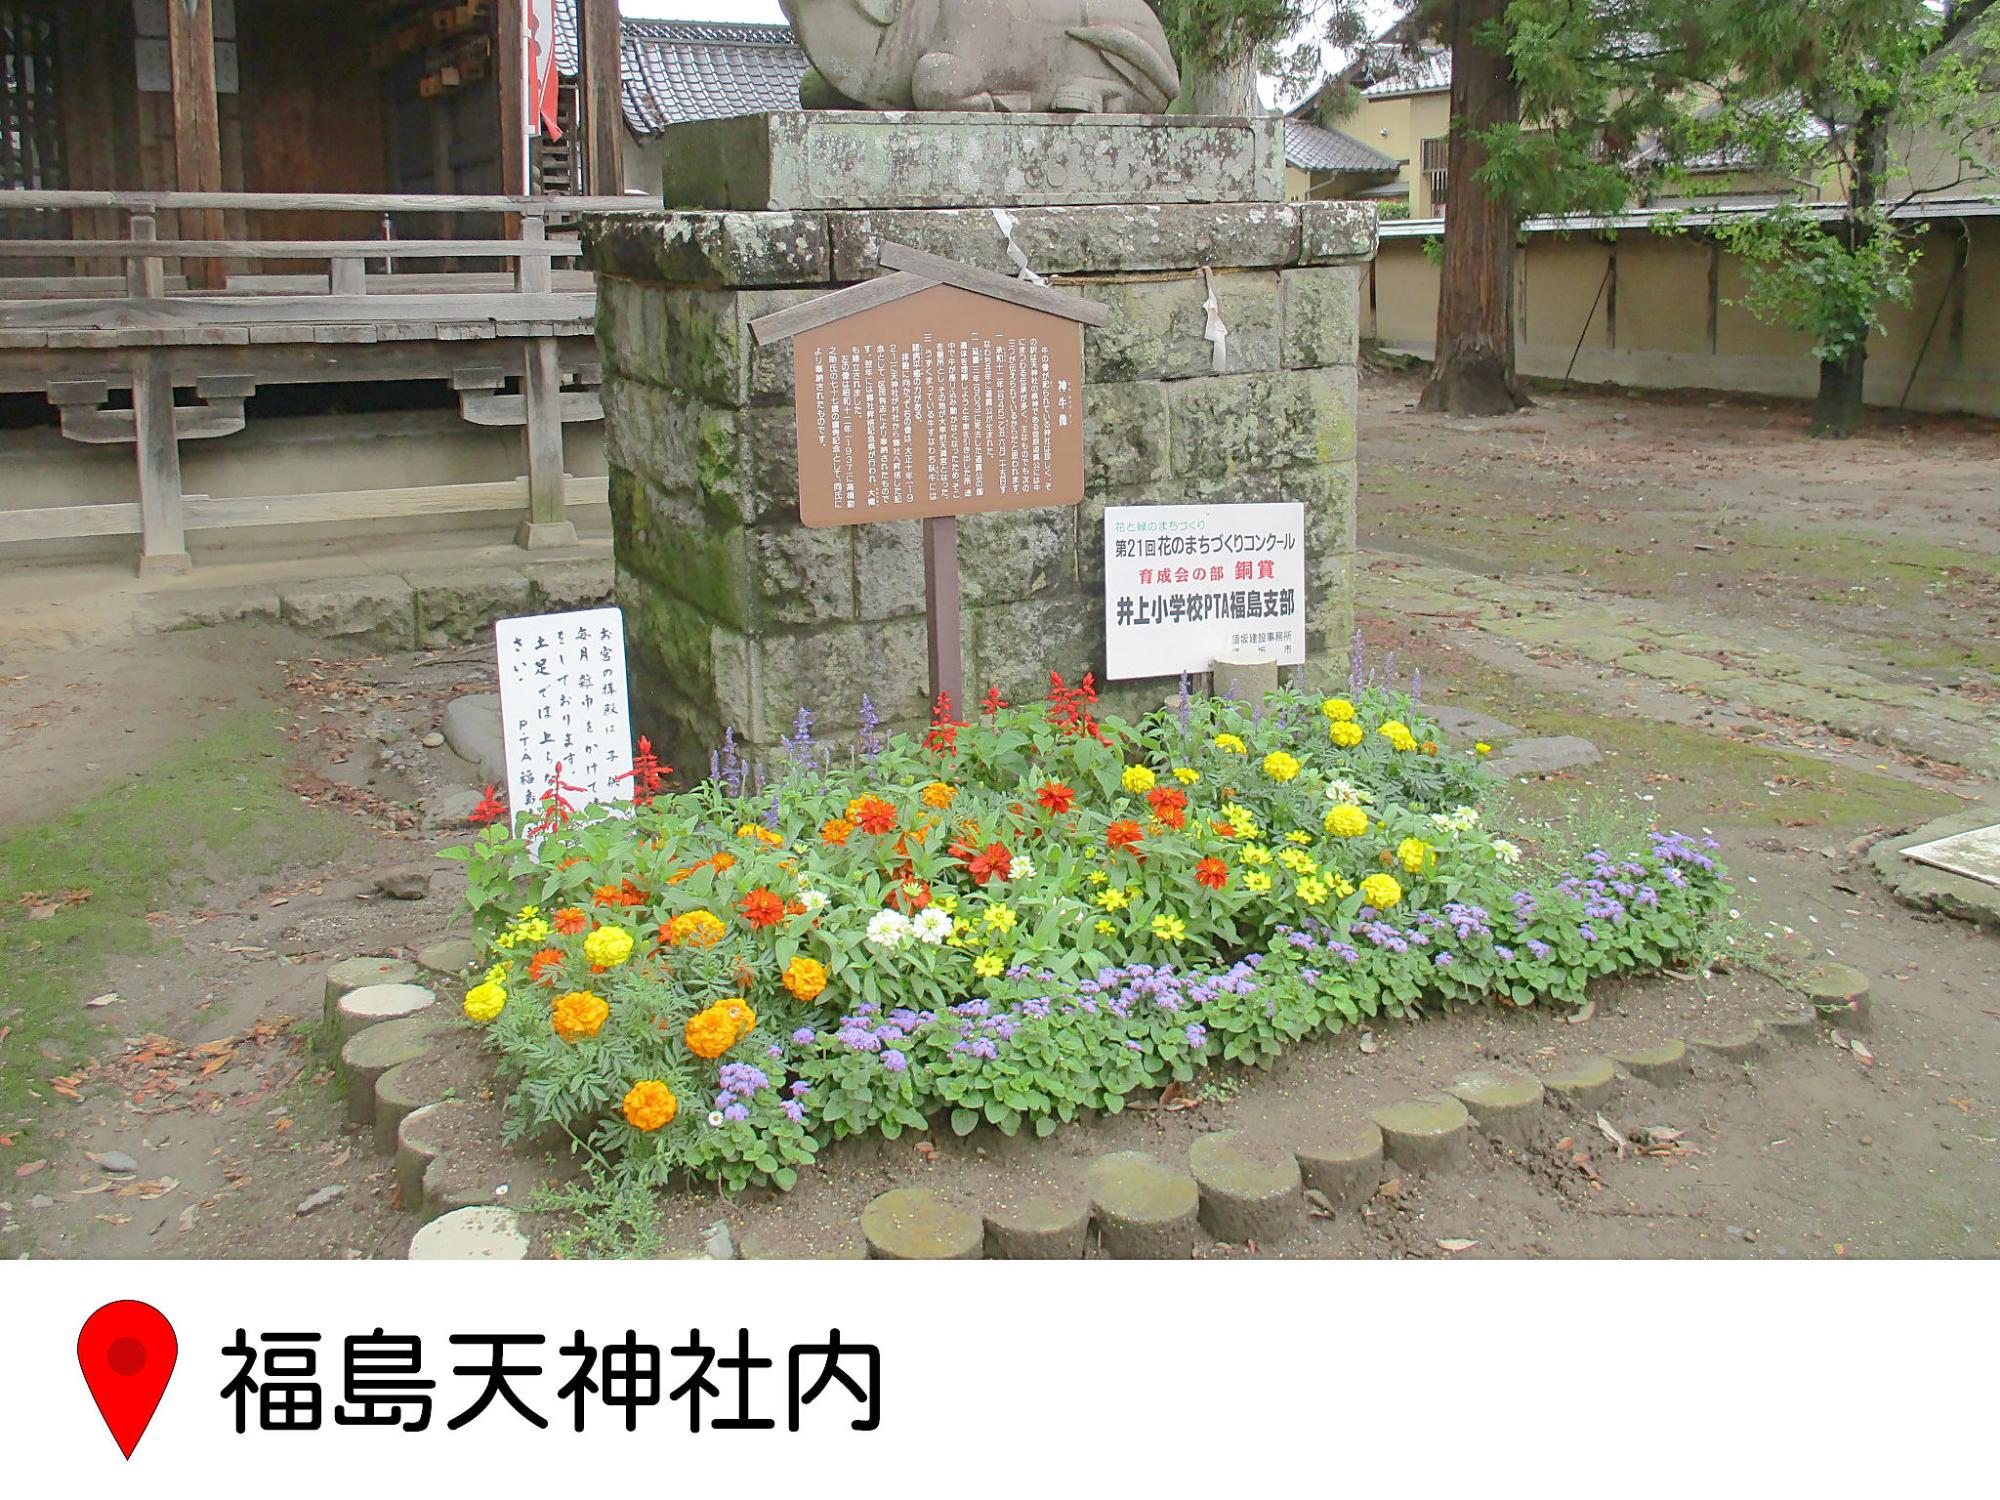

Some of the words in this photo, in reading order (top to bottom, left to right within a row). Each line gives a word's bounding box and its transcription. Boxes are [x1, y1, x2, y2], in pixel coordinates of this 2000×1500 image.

[1116, 520, 1205, 532] 花と緑のまちづくり
[1115, 532, 1296, 558] 第21回花のまちづくりコンクール
[1139, 565, 1224, 585] 育成会の部
[1235, 560, 1275, 580] 銅賞
[1116, 588, 1295, 626] 井上小学校PTA福島支部
